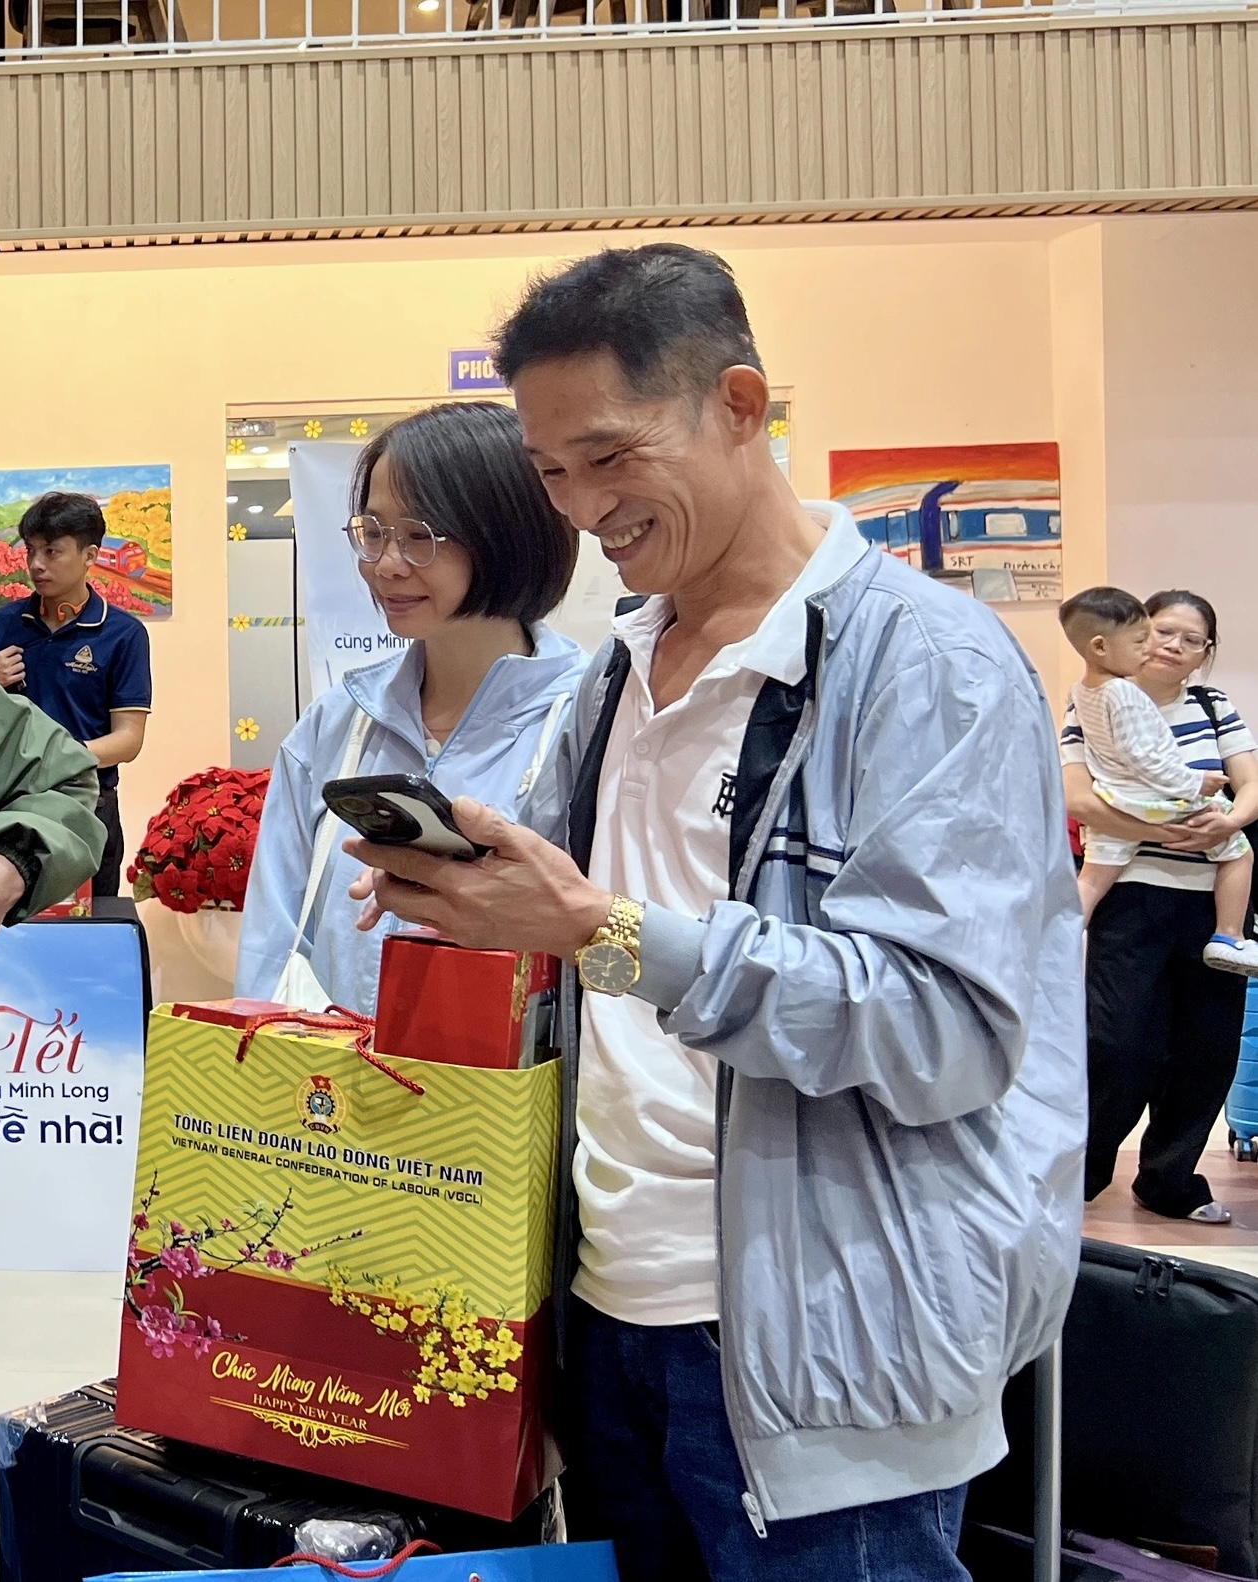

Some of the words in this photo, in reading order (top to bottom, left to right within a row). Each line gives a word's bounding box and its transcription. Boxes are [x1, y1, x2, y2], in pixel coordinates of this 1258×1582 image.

[458, 356, 499, 379] PHÒ
[950, 556, 974, 567] SRT
[335, 632, 371, 652] cùng
[9, 1082, 54, 1099] Minh
[62, 1083, 109, 1102] Long
[41, 1112, 123, 1145] nhà!
[172, 1136, 218, 1154] VIETNAM
[221, 1146, 272, 1165] GENERAL
[275, 1157, 369, 1185] CONFEDERATION
[372, 1176, 388, 1188] OF
[392, 1180, 440, 1197] LABOUR
[444, 1189, 483, 1206] (VGCL)
[218, 1123, 253, 1143] LIÊN
[258, 1131, 302, 1154] ĐOÀN
[307, 1141, 337, 1160] LAO
[343, 1147, 390, 1170] ĐỘNG
[396, 1158, 433, 1179] VIỆT
[439, 1165, 483, 1186] NAM
[211, 1351, 257, 1381] Chúc
[257, 1363, 316, 1403] Mừng
[318, 1374, 364, 1406] Năm
[253, 1393, 296, 1412] HAPPY
[298, 1404, 329, 1421] NEW
[331, 1411, 367, 1431] YEAR
